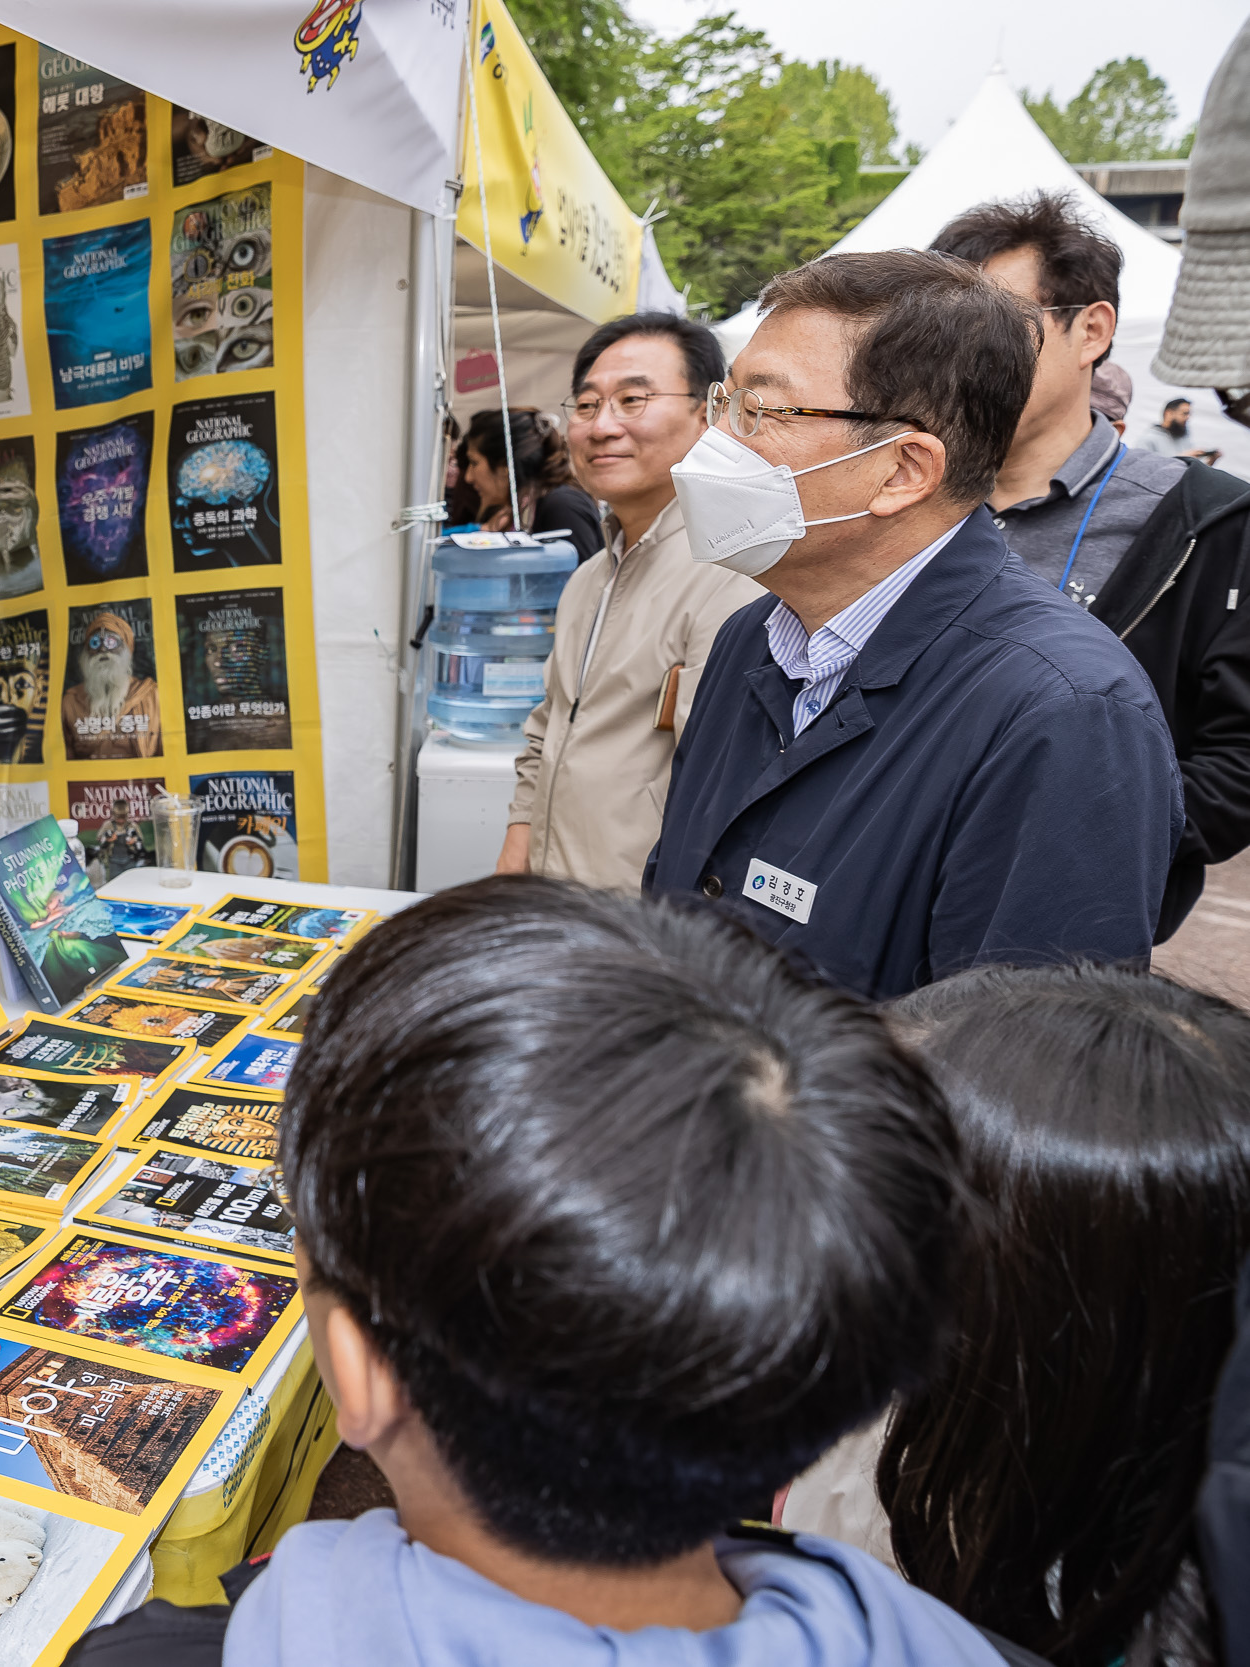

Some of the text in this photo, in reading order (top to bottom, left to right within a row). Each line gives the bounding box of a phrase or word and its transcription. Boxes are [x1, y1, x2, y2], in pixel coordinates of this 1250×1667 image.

[75, 83, 105, 107] 대왕
[73, 248, 118, 268] NATIONAL
[59, 353, 145, 384] 남극대륙의 비밀
[195, 414, 243, 431] NATIONAL
[185, 424, 255, 444] GEOGRAPHIC
[83, 436, 125, 458] NATIONAL
[81, 486, 135, 506] 우주 개발
[82, 502, 134, 524] 경쟁 시대
[193, 507, 258, 526] 중독의 과학
[713, 525, 751, 546] Welkeeps
[198, 616, 263, 633] GEOGRAPHIC
[207, 608, 252, 622] NATIONAL
[17, 642, 41, 657] 과거
[188, 701, 286, 720] 인종이란 무엇인가
[73, 713, 150, 734] 실명의 종말
[83, 786, 149, 802] NATIONAL
[207, 777, 277, 795] NATIONAL
[200, 792, 293, 813] GEOGRAPHIC
[237, 814, 288, 838] 카페인
[2, 837, 54, 873] STUNNING
[2, 849, 72, 896] PHOTOGRAPHS
[769, 893, 797, 912] 광진구청장
[168, 1101, 215, 1139] 투탕카멘과
[15, 1140, 51, 1164] 살리다
[164, 1180, 186, 1199] NATIONAL
[193, 1182, 237, 1219] 세상을 바꾼
[218, 1188, 269, 1223] 100가지
[261, 1203, 283, 1220] 사건
[12, 1283, 44, 1307] NATIONAL
[22, 1280, 60, 1310] GEOGRAPHIC
[70, 1270, 140, 1320] 새로운
[121, 1266, 187, 1309] 우주
[74, 1377, 135, 1430] 미스터리
